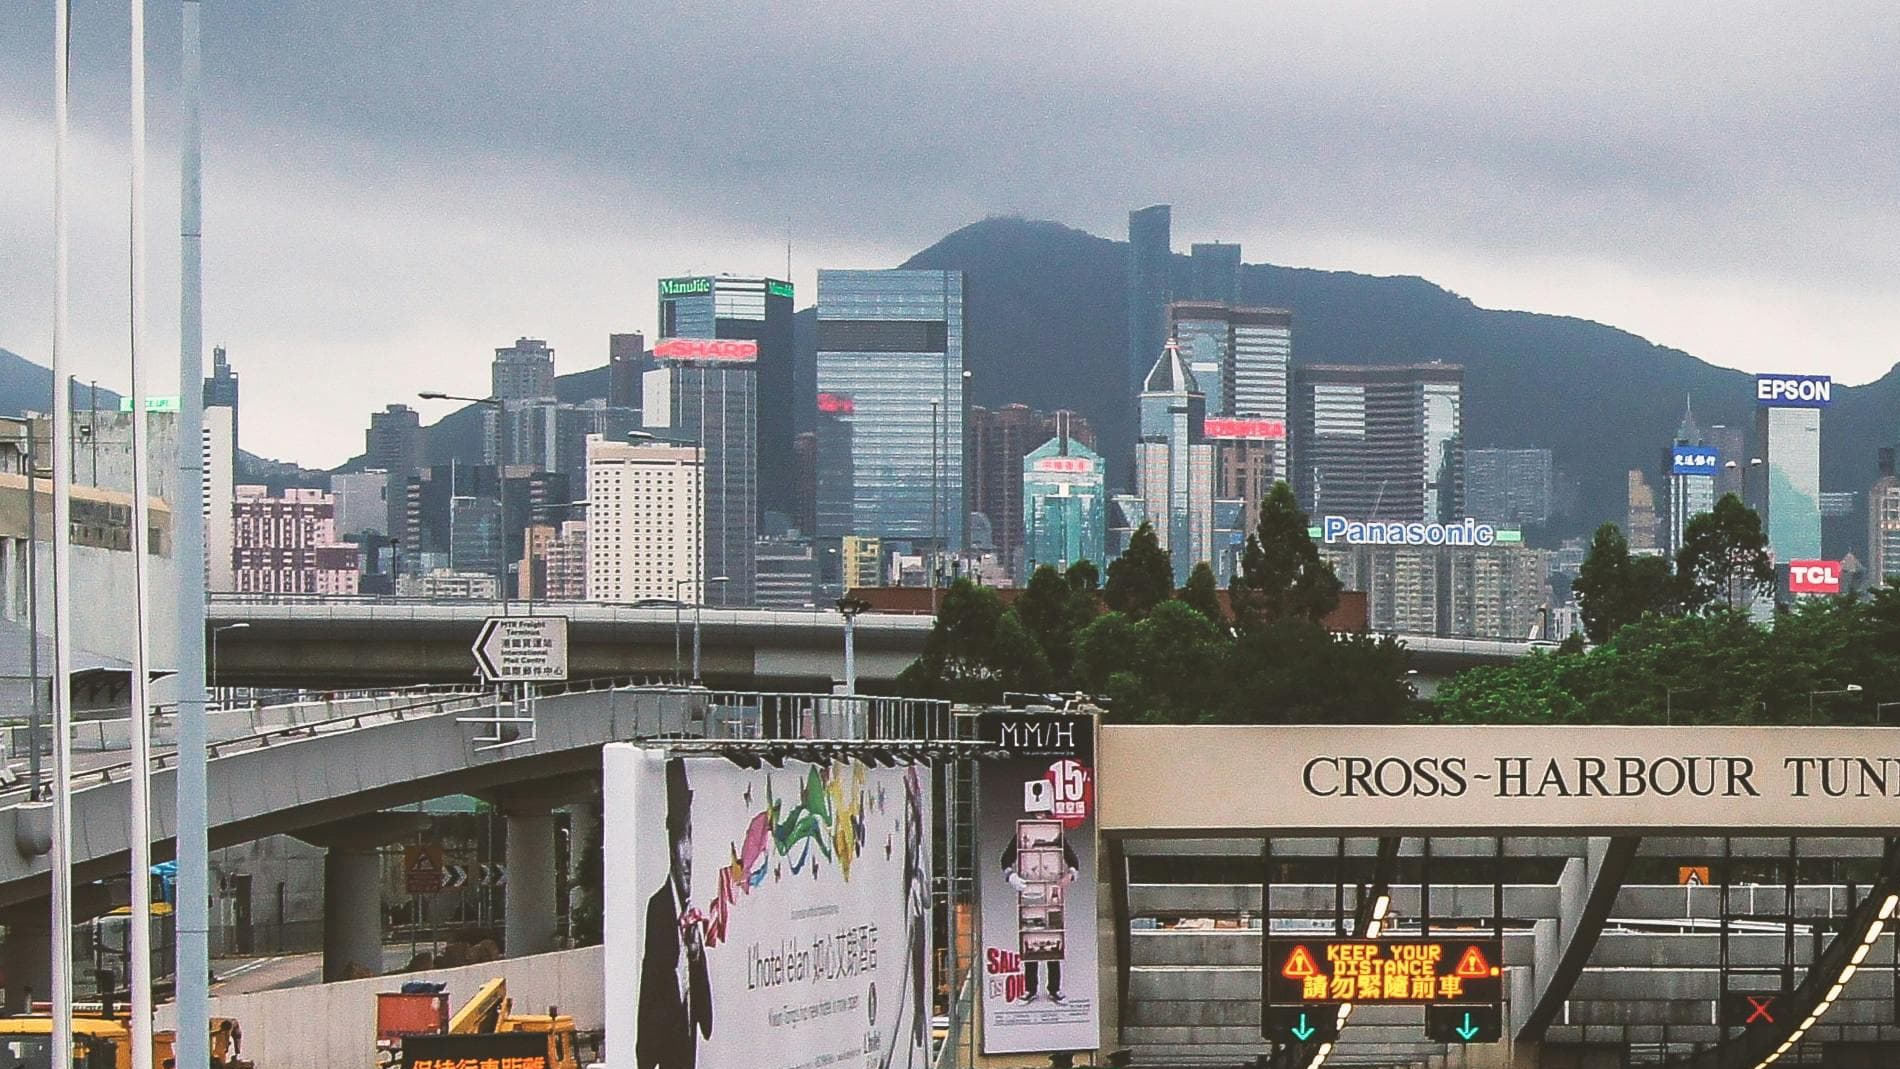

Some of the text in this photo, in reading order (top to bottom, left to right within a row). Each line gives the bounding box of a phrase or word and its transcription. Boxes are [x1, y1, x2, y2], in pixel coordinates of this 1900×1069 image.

[661, 280, 710, 295] Manulife
[1758, 379, 1831, 401] EPSON
[1325, 516, 1494, 546] Panasonic
[1790, 566, 1839, 585] TCL
[1327, 943, 1442, 961] KEEP YOUR
[1334, 961, 1435, 976] DISTANCE
[1303, 976, 1464, 999] 請勿緊隨前車
